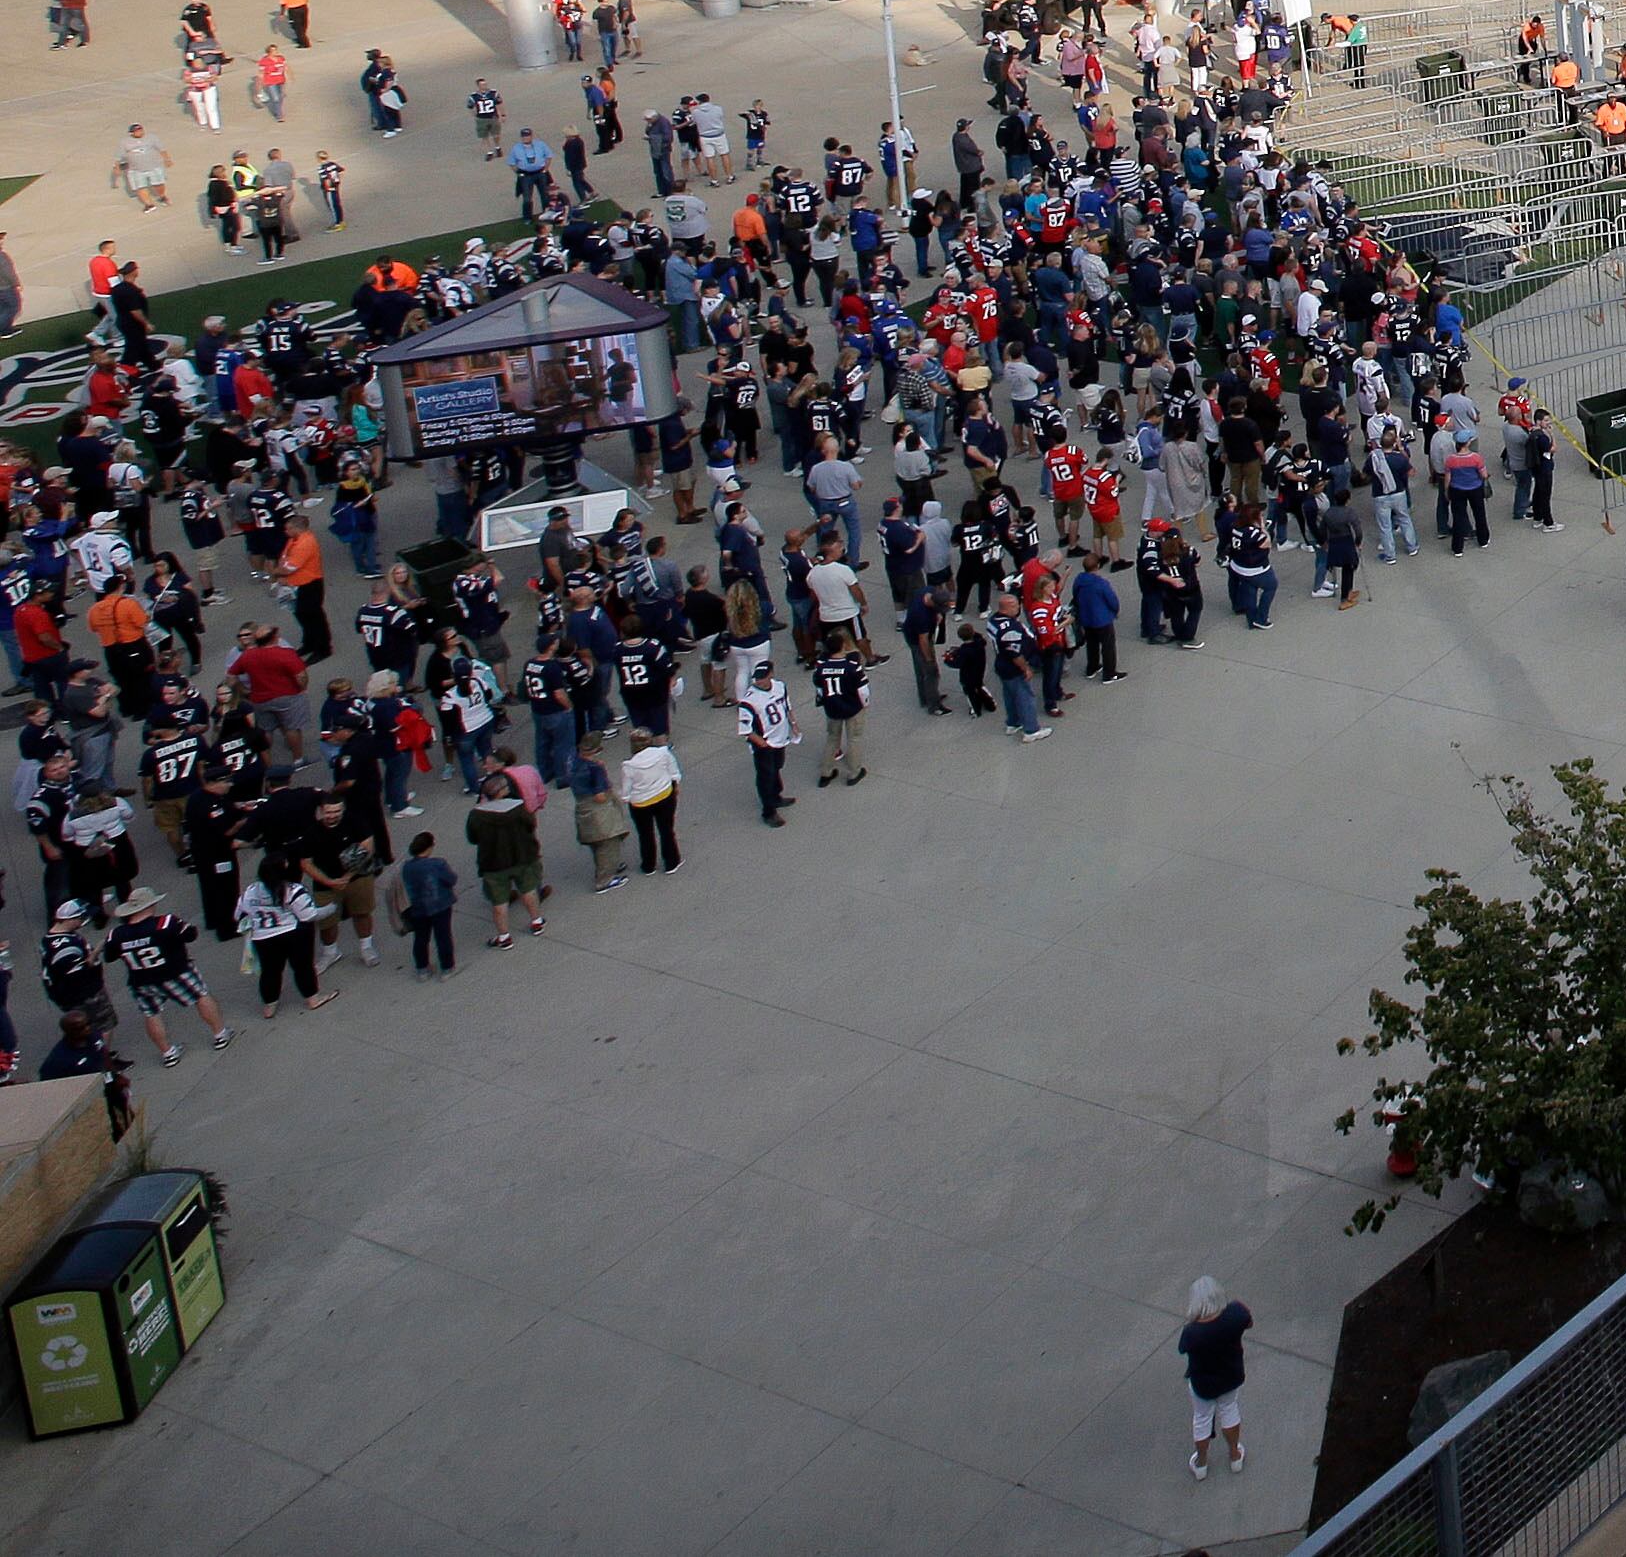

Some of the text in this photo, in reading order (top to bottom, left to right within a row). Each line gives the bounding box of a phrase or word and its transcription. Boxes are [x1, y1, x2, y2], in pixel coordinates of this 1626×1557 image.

[841, 168, 862, 186] 87
[1059, 167, 1073, 182] 12
[787, 194, 811, 213] 12
[269, 335, 292, 352] 15
[435, 395, 494, 410] GALLERY
[812, 415, 831, 431] 61
[1052, 464, 1074, 482] 12
[963, 534, 983, 551] 12
[5, 578, 30, 606] 10
[622, 664, 649, 686] 12
[525, 675, 547, 699] 12
[824, 677, 843, 697] 11
[468, 691, 482, 708] 12
[158, 750, 198, 782] 87
[121, 946, 166, 971] 12
